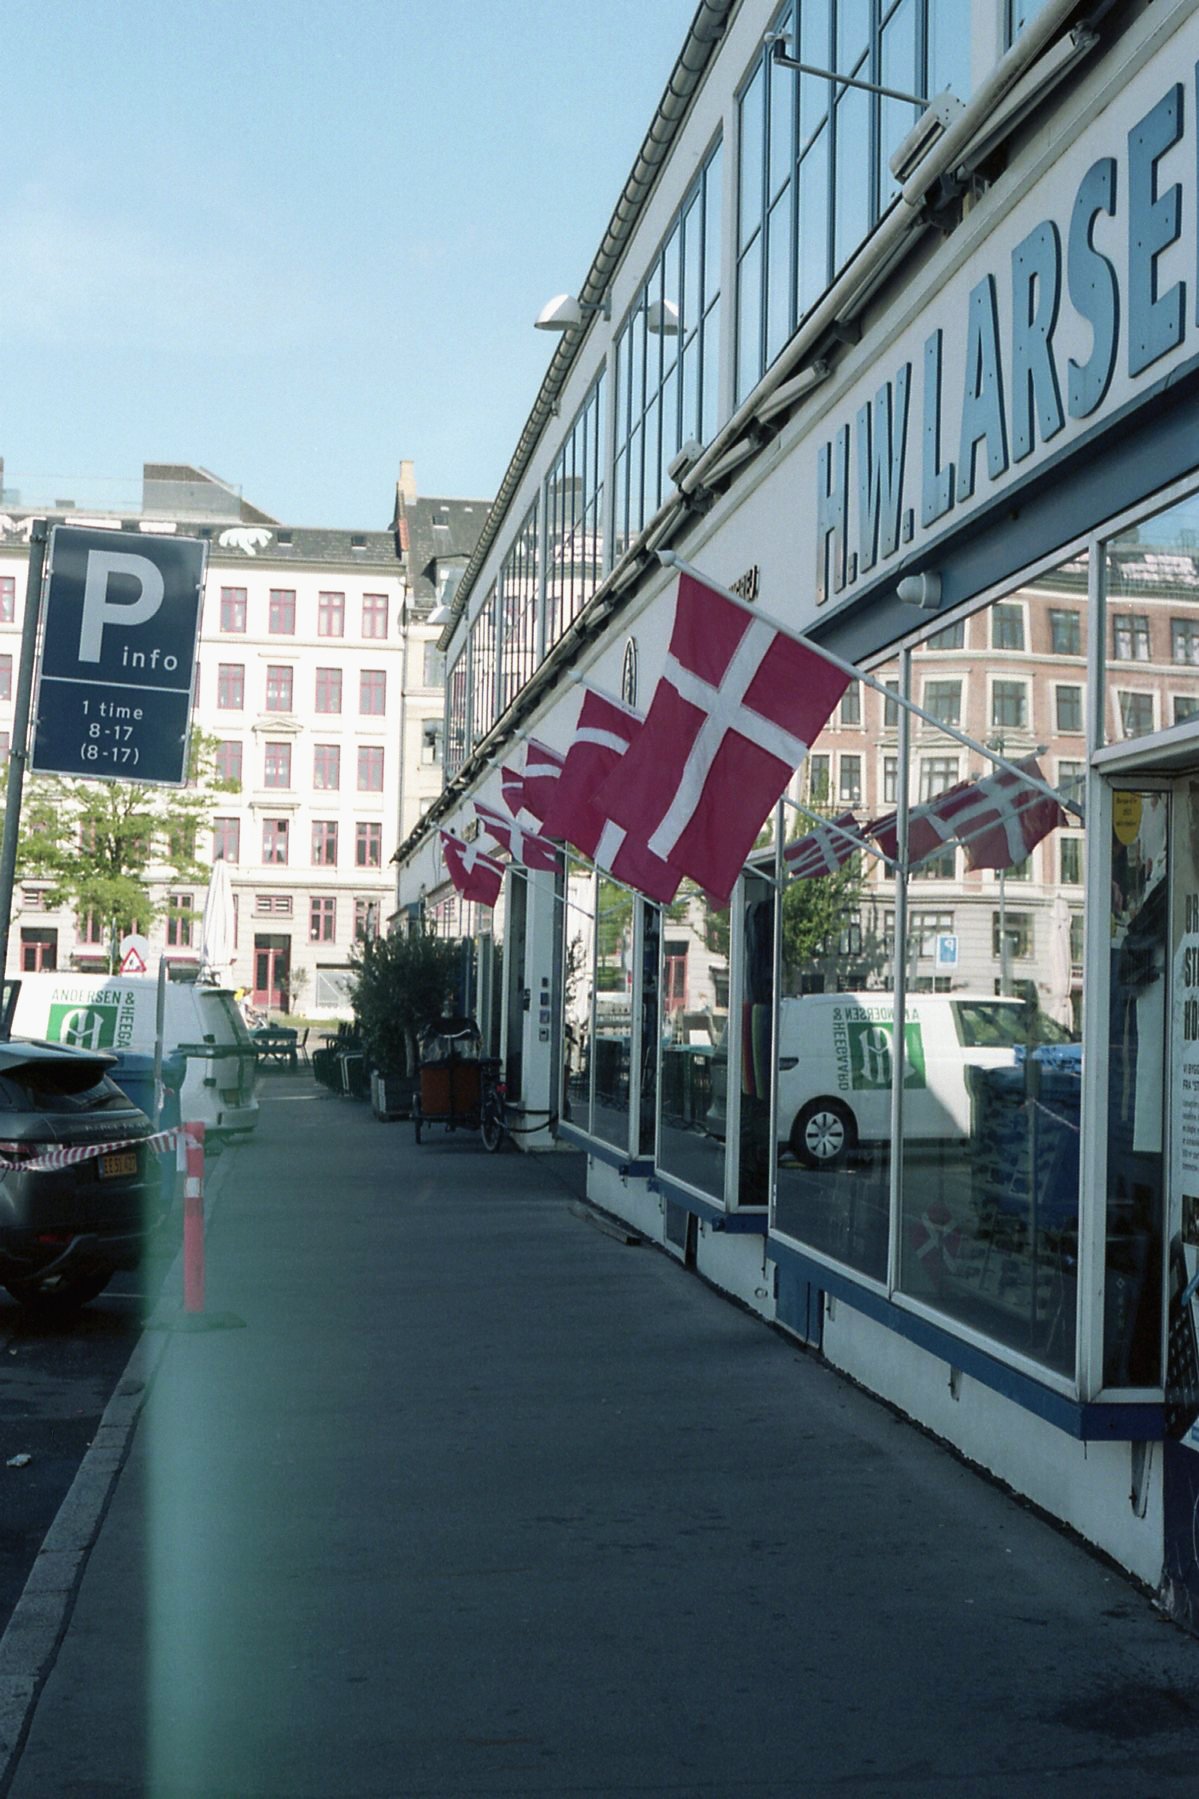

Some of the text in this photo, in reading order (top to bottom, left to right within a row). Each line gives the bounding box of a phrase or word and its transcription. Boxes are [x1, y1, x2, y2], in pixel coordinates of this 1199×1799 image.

[921, 58, 1199, 529] LARSE
[78, 549, 164, 663] P
[122, 646, 178, 670] info
[82, 700, 143, 720] 1 time
[89, 723, 133, 741] 8-17
[80, 743, 140, 765] (8-17)
[1184, 946, 1199, 987] ST
[52, 988, 135, 1004] ANDERSEN &
